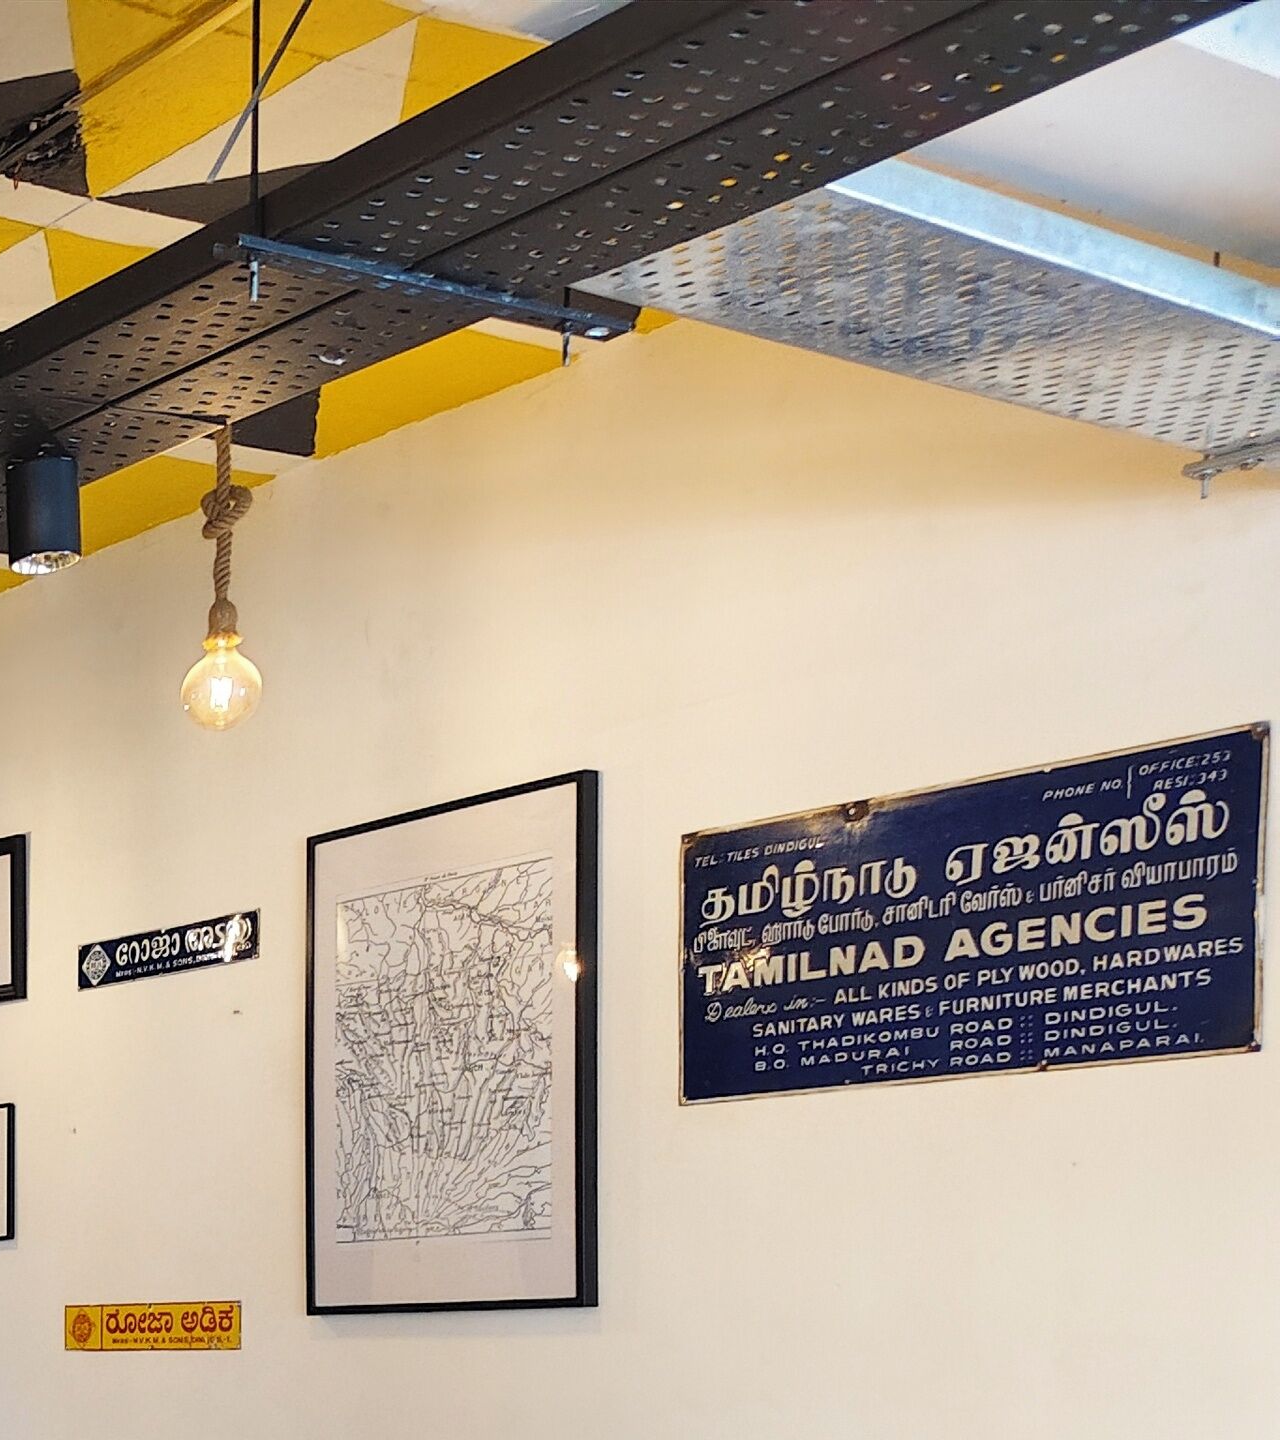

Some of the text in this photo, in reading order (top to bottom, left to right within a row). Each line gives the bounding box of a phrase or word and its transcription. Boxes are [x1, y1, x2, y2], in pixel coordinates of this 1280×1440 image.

[1042, 783, 1095, 801] PHONE
[727, 848, 759, 863] TILES
[763, 835, 824, 856] DINDIGUL
[1121, 848, 1239, 890] வியாபாரம்
[699, 857, 917, 928] தமிழ்நாடு
[697, 893, 1209, 997] TAMILNAD AGENCIES
[705, 998, 777, 1023] Dealers
[833, 988, 873, 1005] ALL
[878, 976, 938, 999] KINDS
[944, 971, 971, 991] OF
[977, 965, 1016, 988] PLY
[1092, 936, 1245, 972] HARDWARES
[752, 1013, 845, 1038] SANITARY
[851, 1003, 921, 1027] WARES
[939, 986, 1058, 1017] FURNITURE
[1063, 967, 1213, 1002] MERCHANTS
[797, 1026, 940, 1052] THADIKOMBU
[949, 1016, 1013, 1036] ROAD
[800, 1046, 910, 1067] MADURAI
[949, 1034, 1013, 1051] ROAD
[861, 1057, 940, 1077] TRICHY
[949, 1051, 1013, 1068] ROAD
